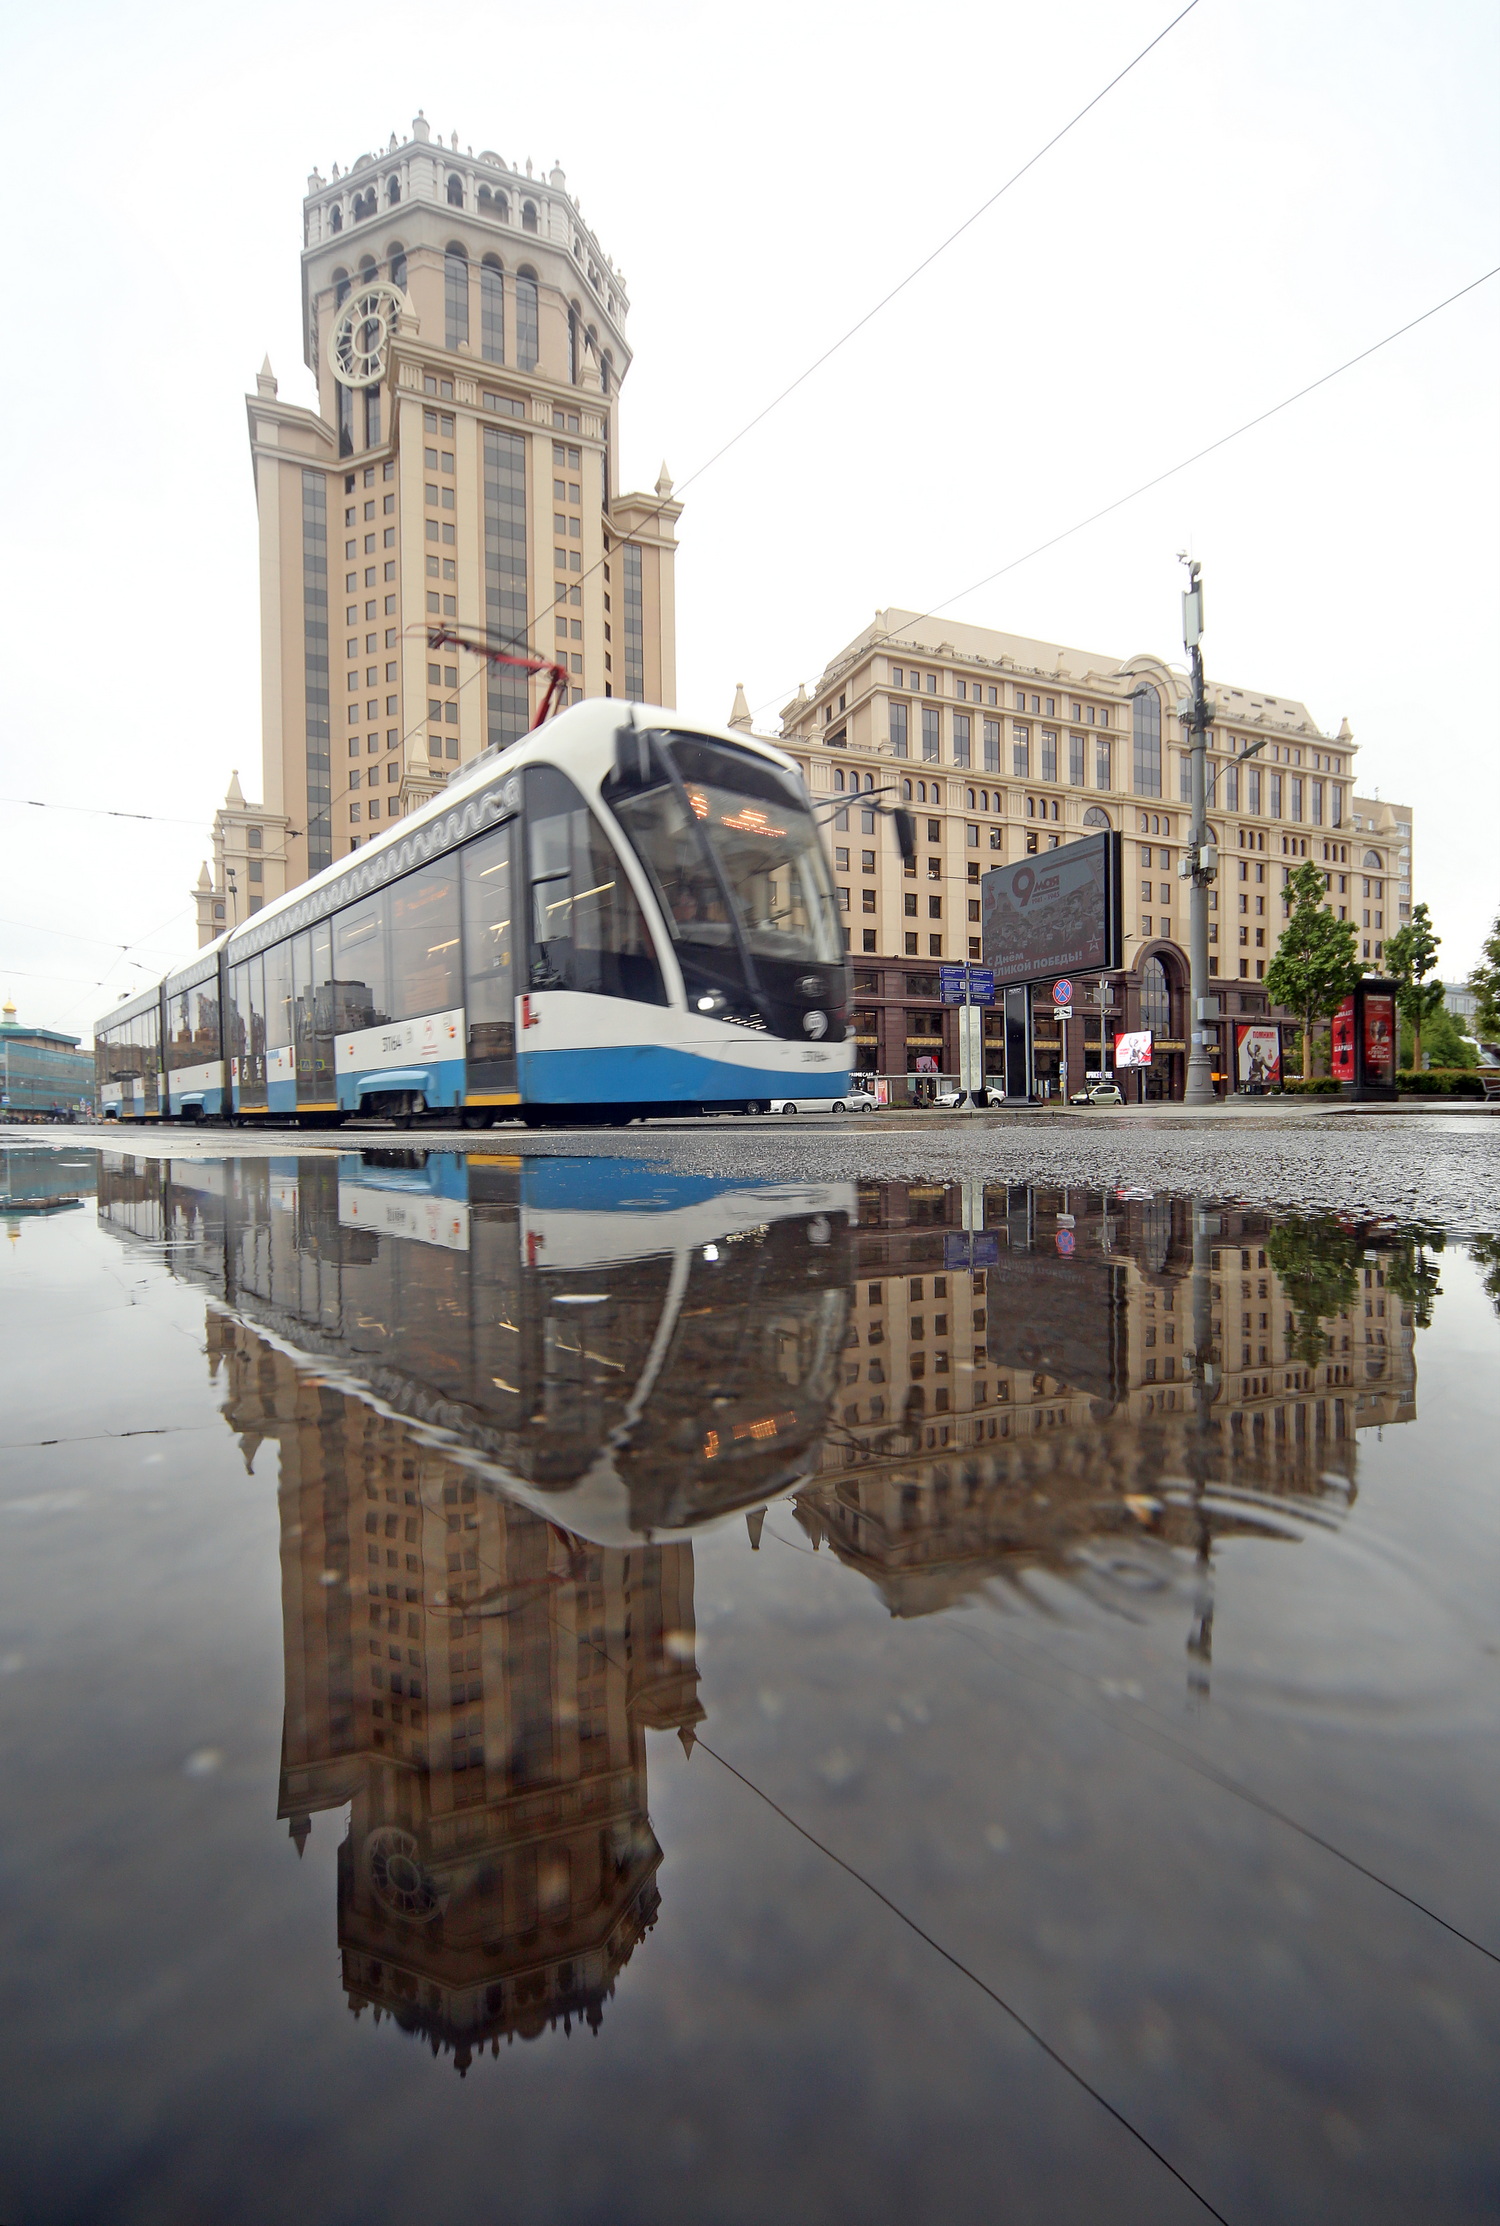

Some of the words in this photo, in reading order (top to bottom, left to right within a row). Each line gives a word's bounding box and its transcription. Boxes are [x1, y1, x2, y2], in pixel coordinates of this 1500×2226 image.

[1012, 867, 1035, 907] 9
[993, 959, 1031, 977] ЕЛИКОЙ
[1033, 951, 1083, 969] ПОБЕДЫ!
[994, 952, 1024, 967] Днём
